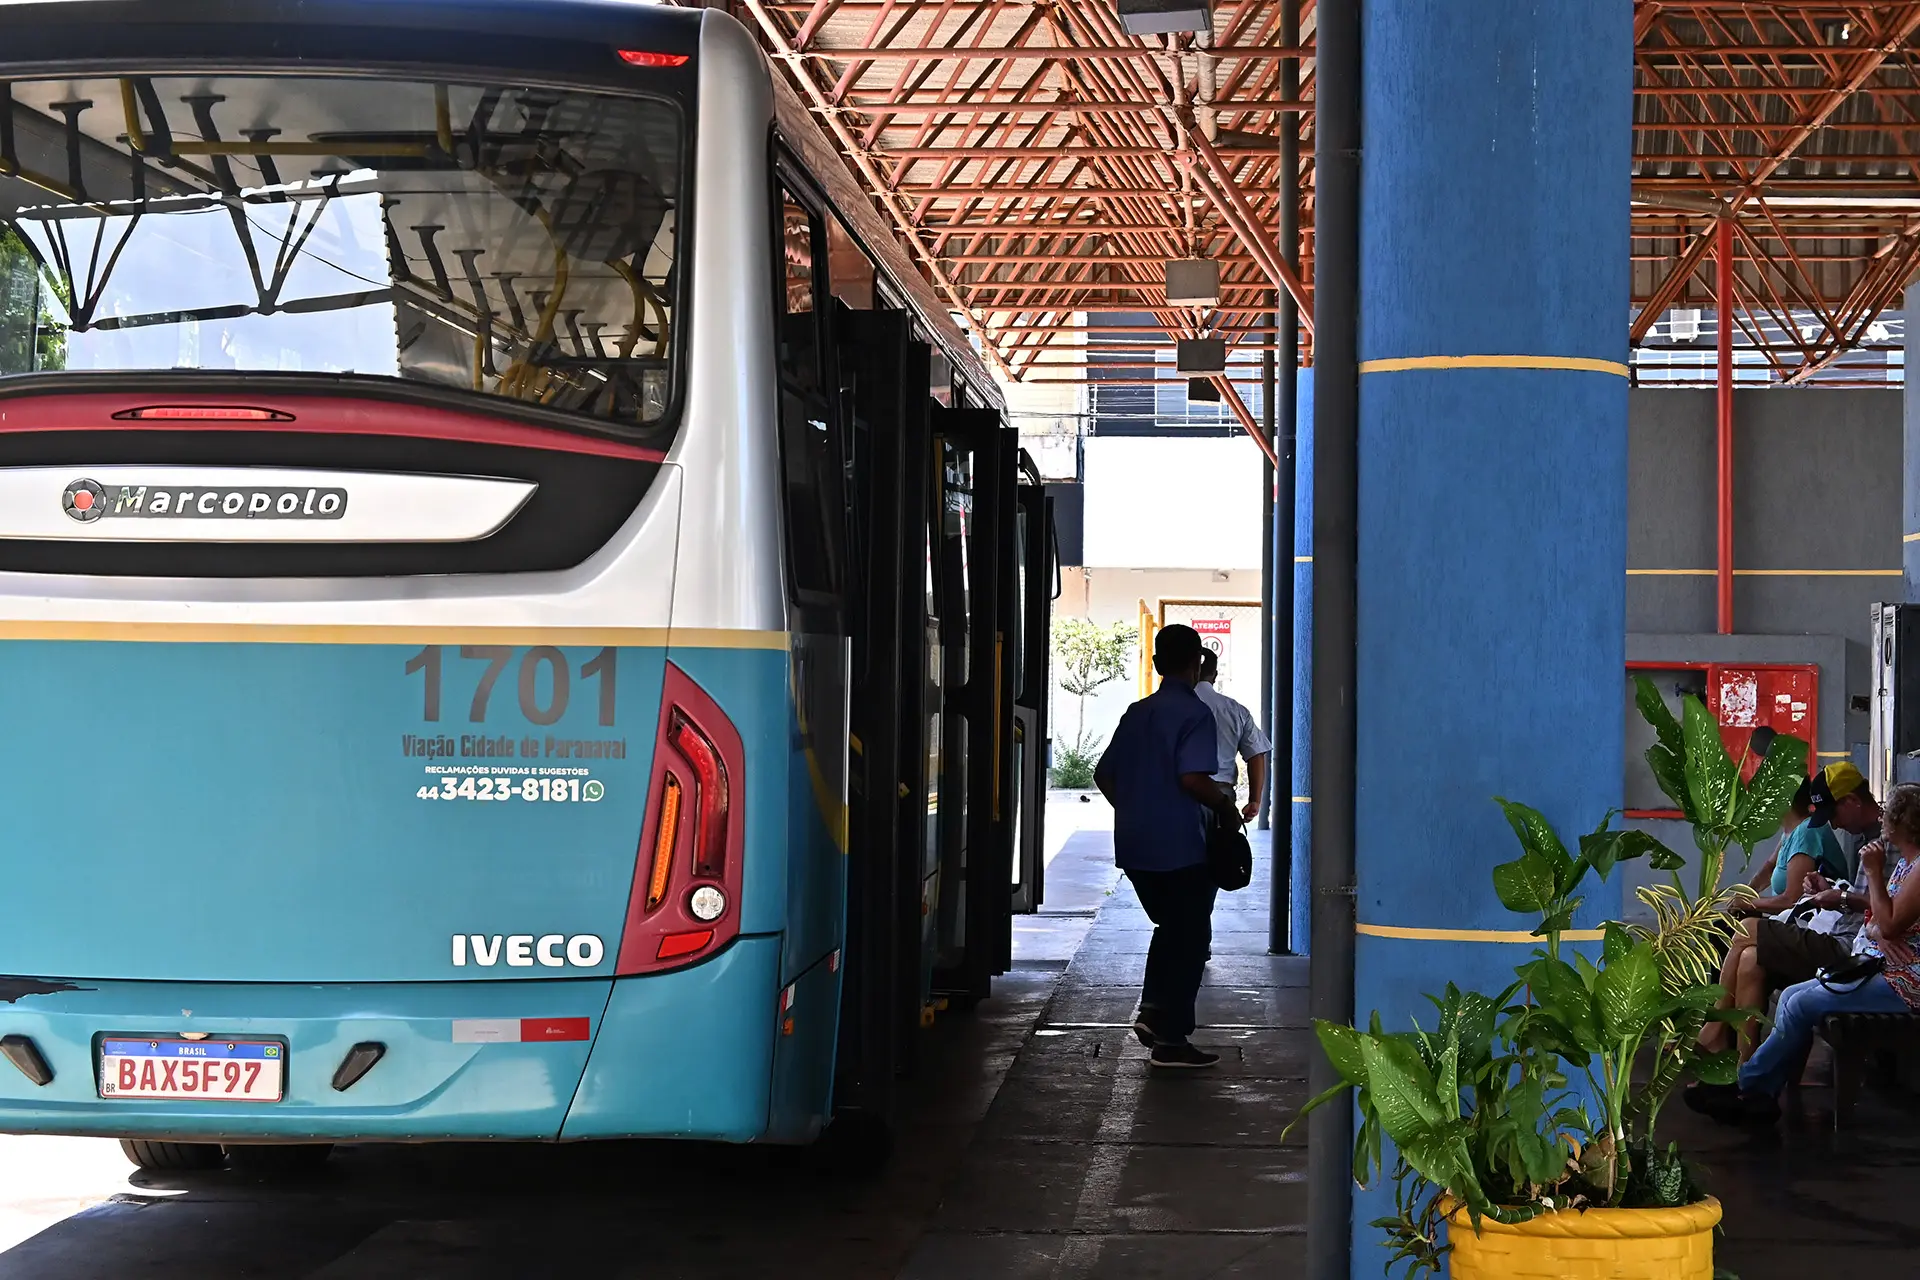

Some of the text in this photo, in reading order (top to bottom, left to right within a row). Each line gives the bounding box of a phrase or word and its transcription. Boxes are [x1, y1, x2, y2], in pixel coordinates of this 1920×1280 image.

[114, 486, 341, 518] Marcopolo
[1192, 622, 1230, 631] ATENÇÃO
[405, 644, 617, 727] 1701
[402, 734, 455, 760] Viação
[460, 734, 515, 758] Cidade
[520, 736, 539, 758] de
[425, 765, 489, 776] RECLAMAÇÕES
[491, 767, 530, 776] DUVIDAS
[531, 767, 537, 776] E
[416, 777, 580, 802] 44 3423-8181
[452, 934, 604, 967] IVECO
[178, 1046, 207, 1056] BRASIL
[105, 1083, 116, 1093] BR
[118, 1058, 262, 1094] BAX5F97
